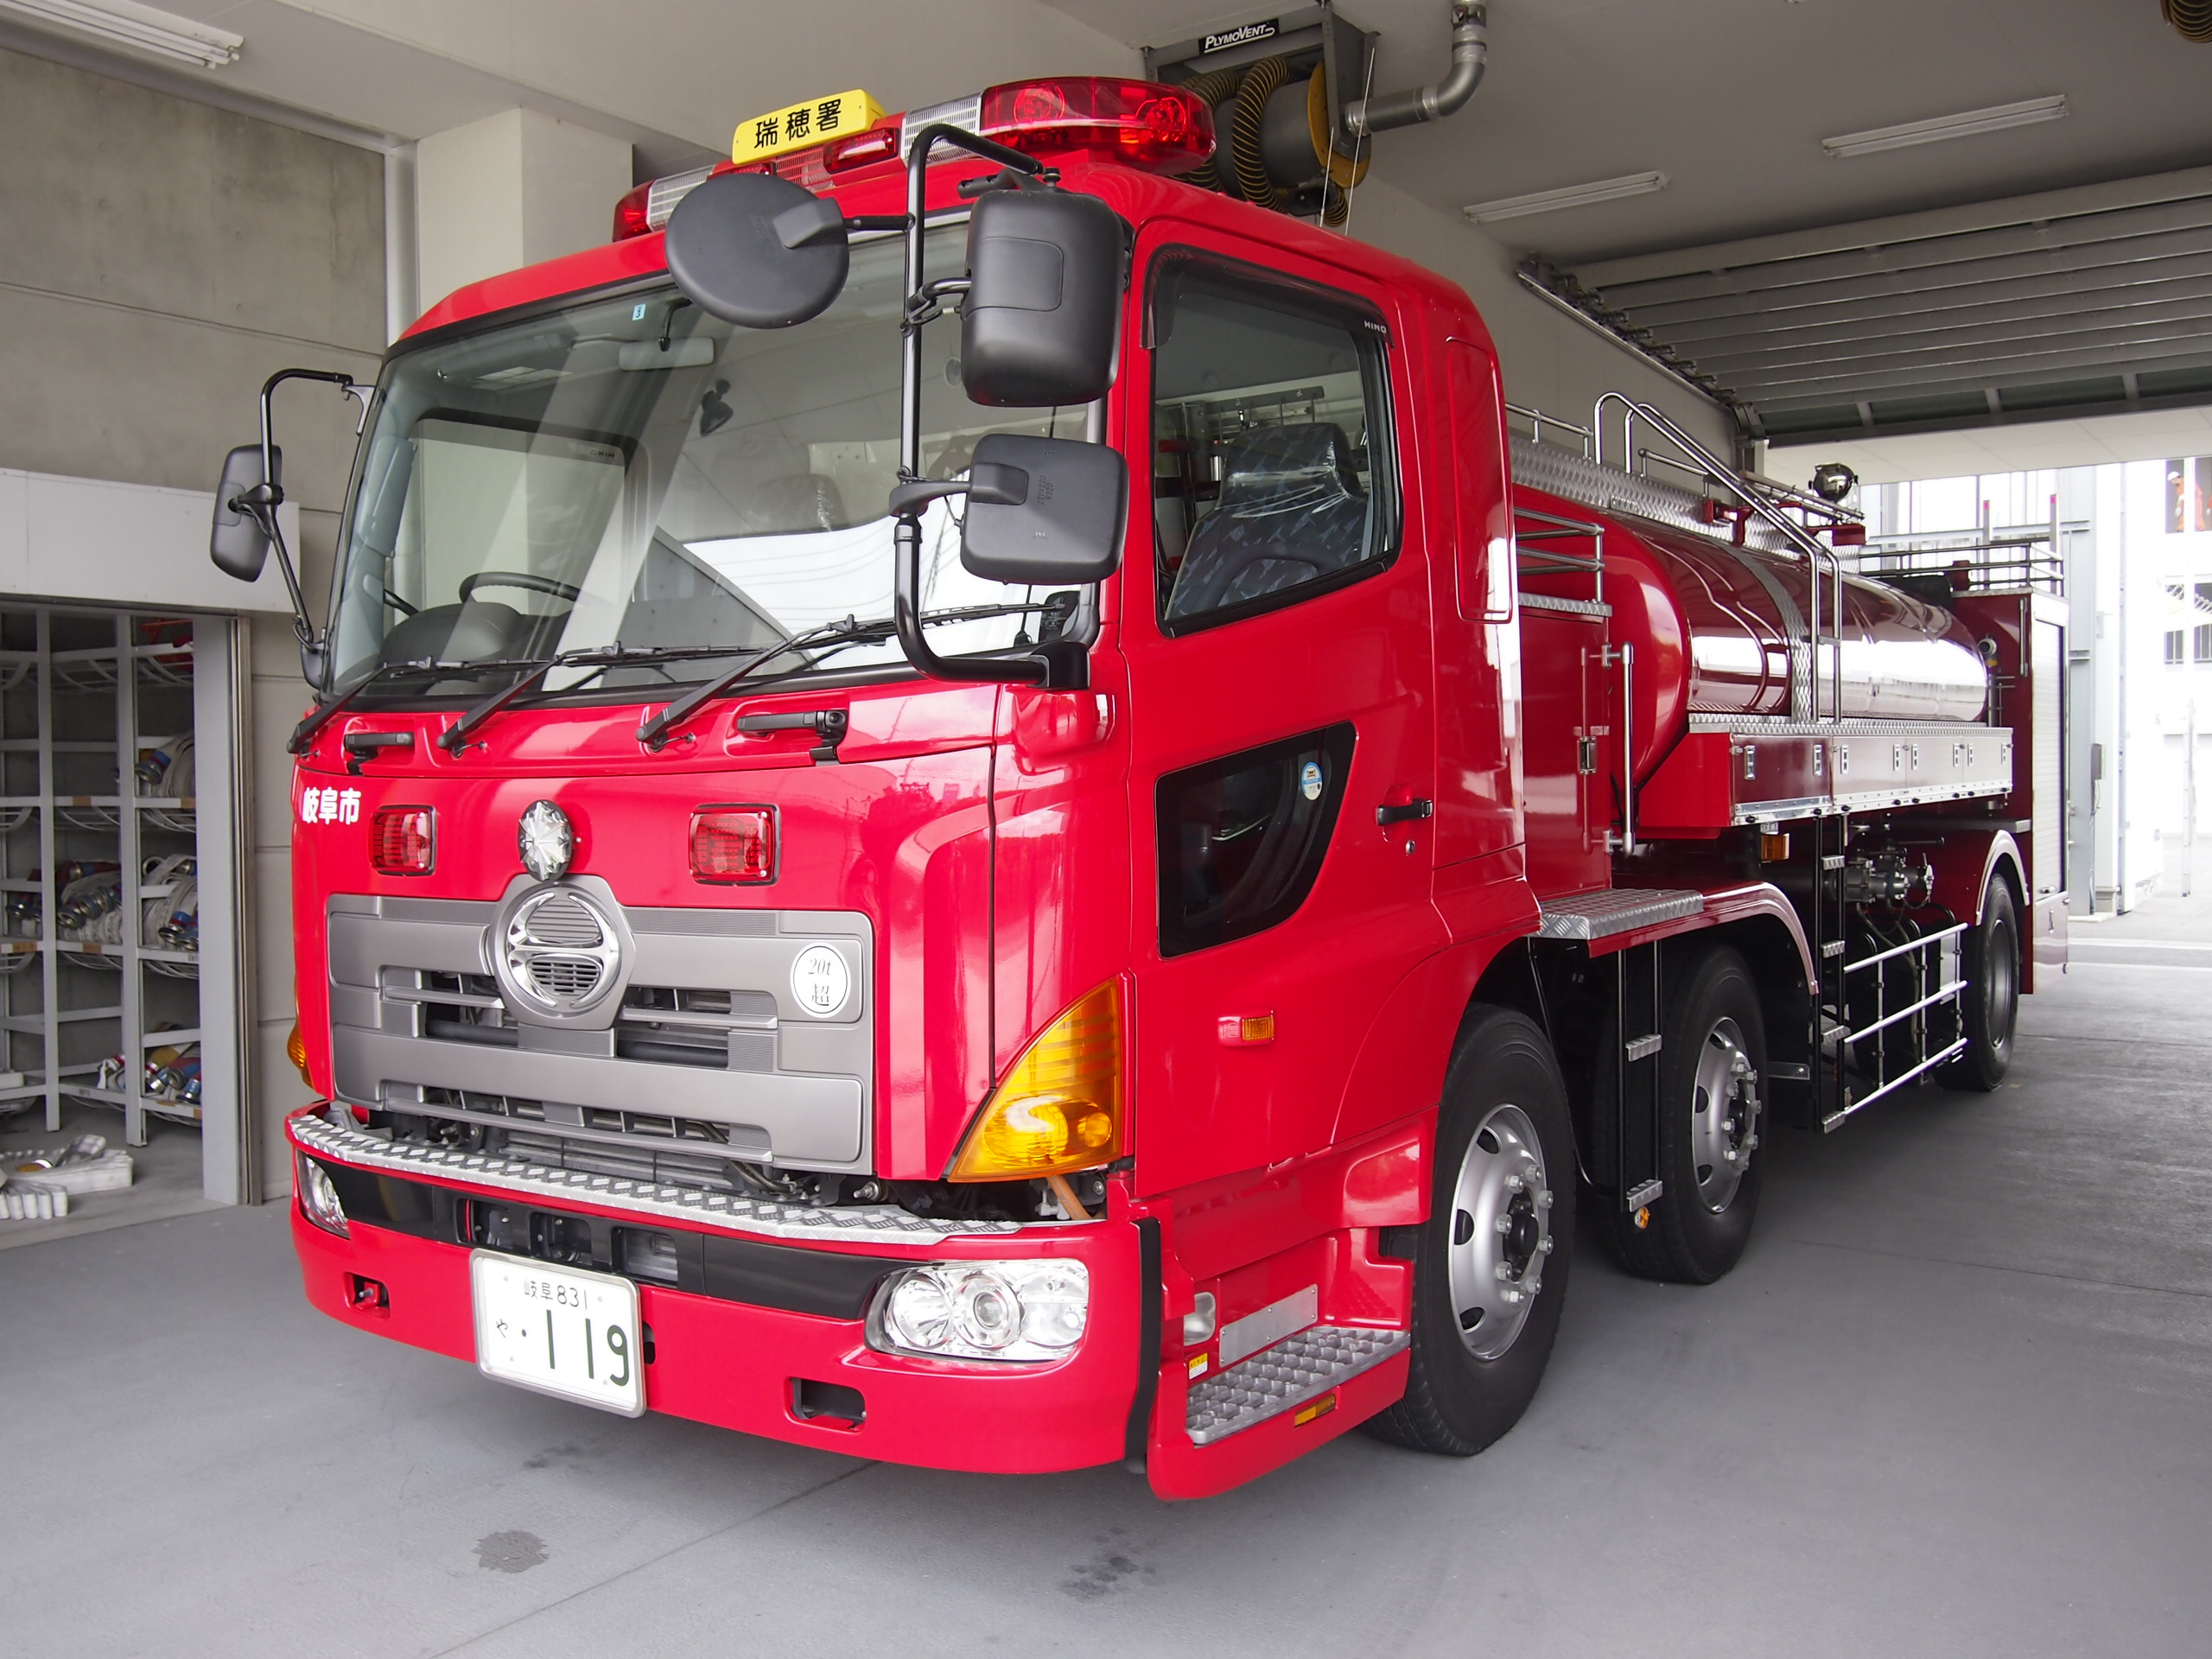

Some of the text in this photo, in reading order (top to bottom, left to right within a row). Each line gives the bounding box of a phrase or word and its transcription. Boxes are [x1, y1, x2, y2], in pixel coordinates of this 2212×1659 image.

[753, 99, 842, 149] 瑞穂署
[1363, 321, 1387, 334] HINO
[302, 786, 361, 825] 岐阜市
[808, 958, 830, 976] 20t
